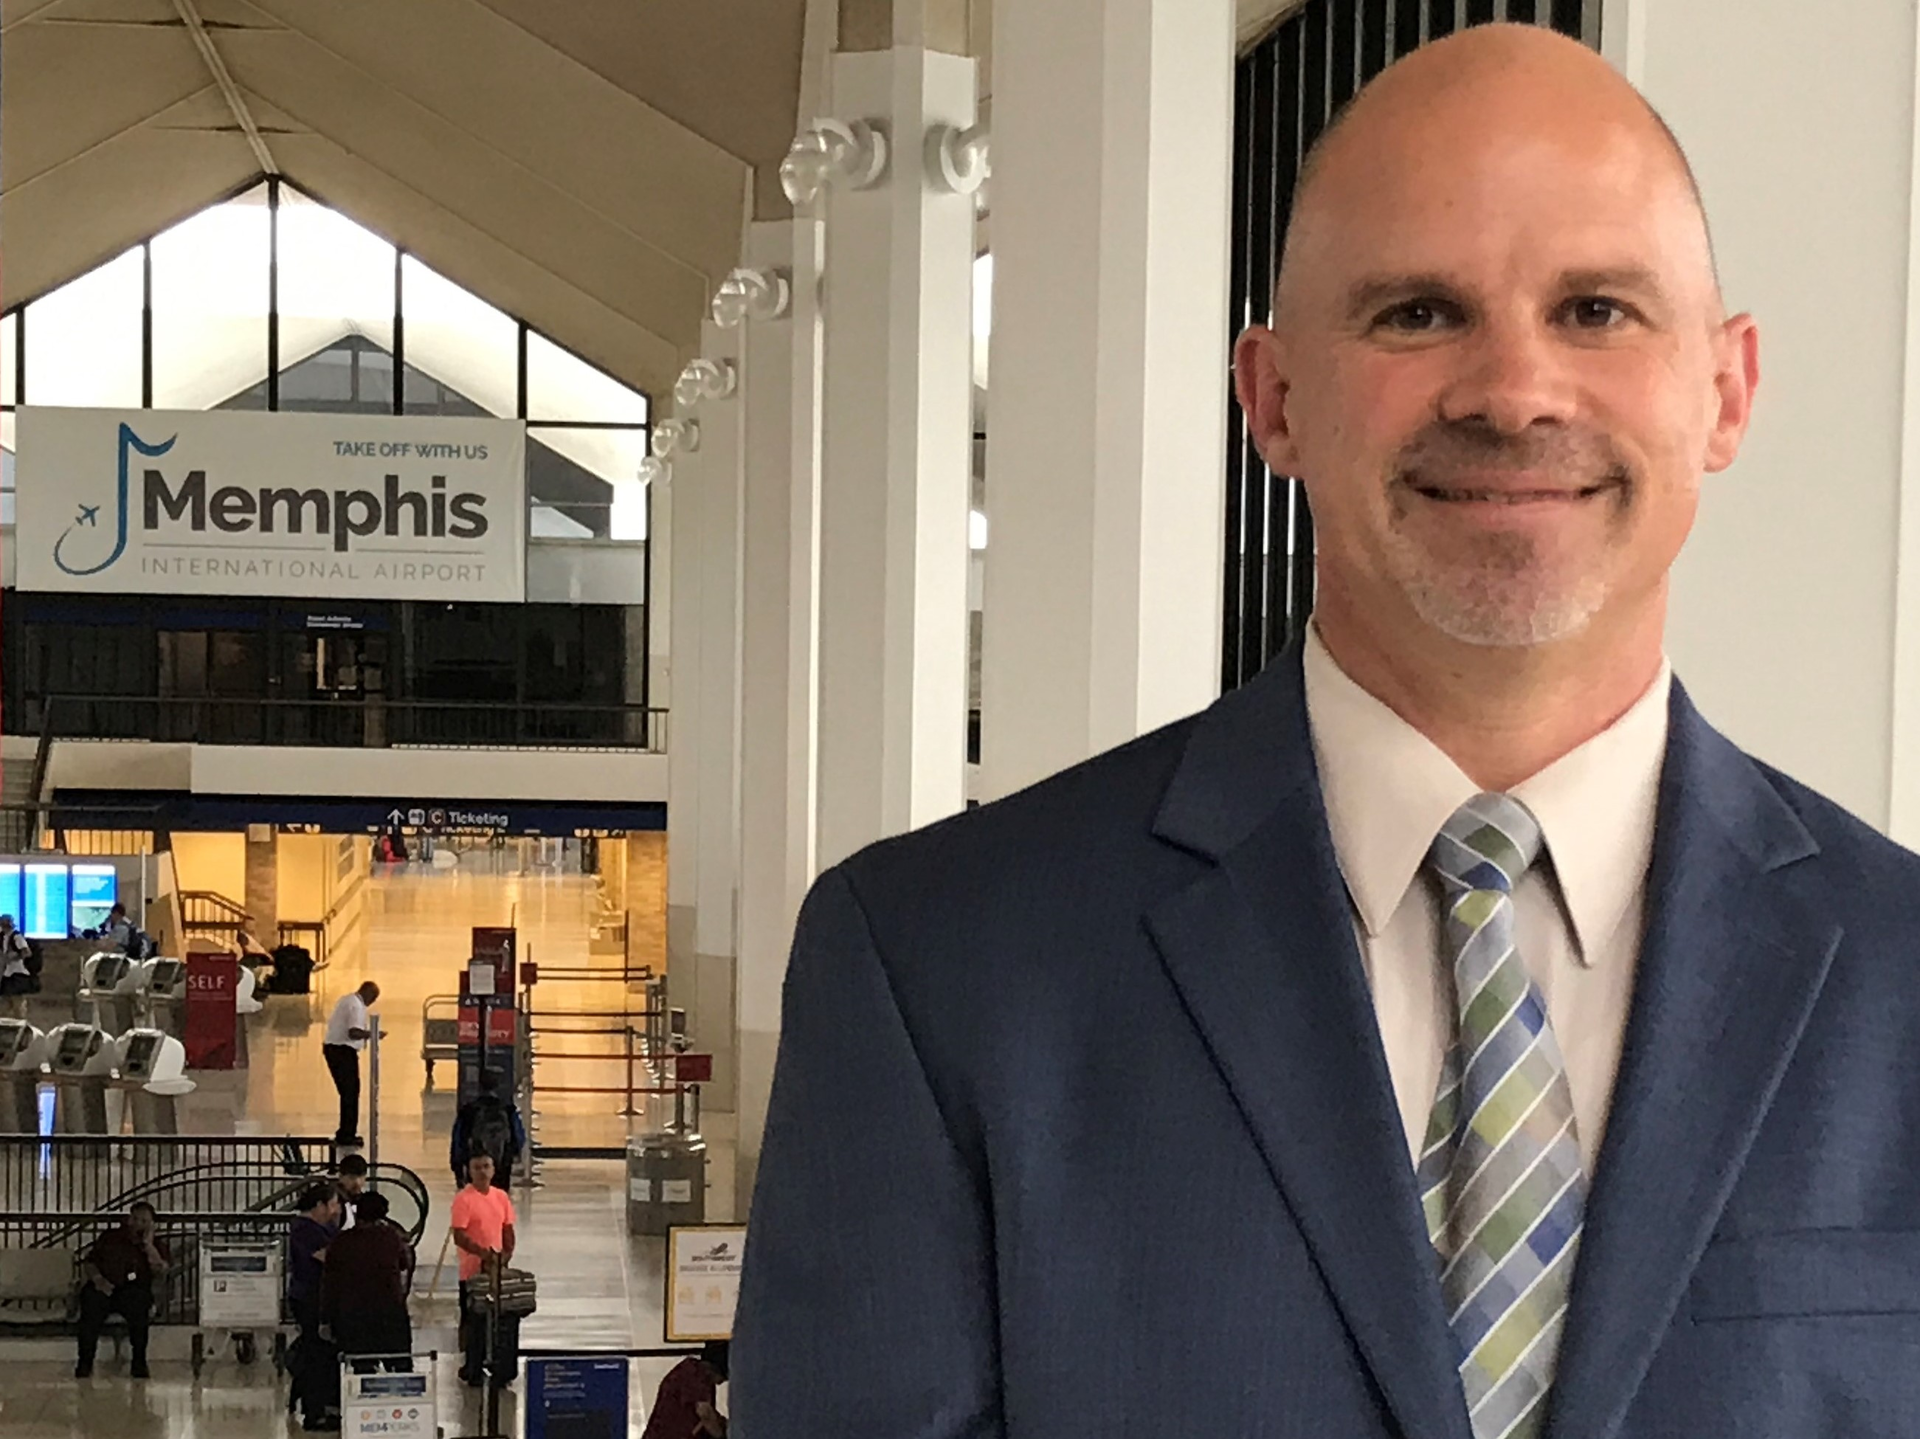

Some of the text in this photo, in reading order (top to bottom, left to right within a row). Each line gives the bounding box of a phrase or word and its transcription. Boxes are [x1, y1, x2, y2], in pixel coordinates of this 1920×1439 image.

[333, 441, 489, 460] TAKE OFF WITH US
[143, 469, 489, 552] Memphis
[141, 556, 487, 583] INTERNATIONAL AIRPORT
[448, 811, 509, 827] Ticketing
[187, 974, 226, 990] SELF
